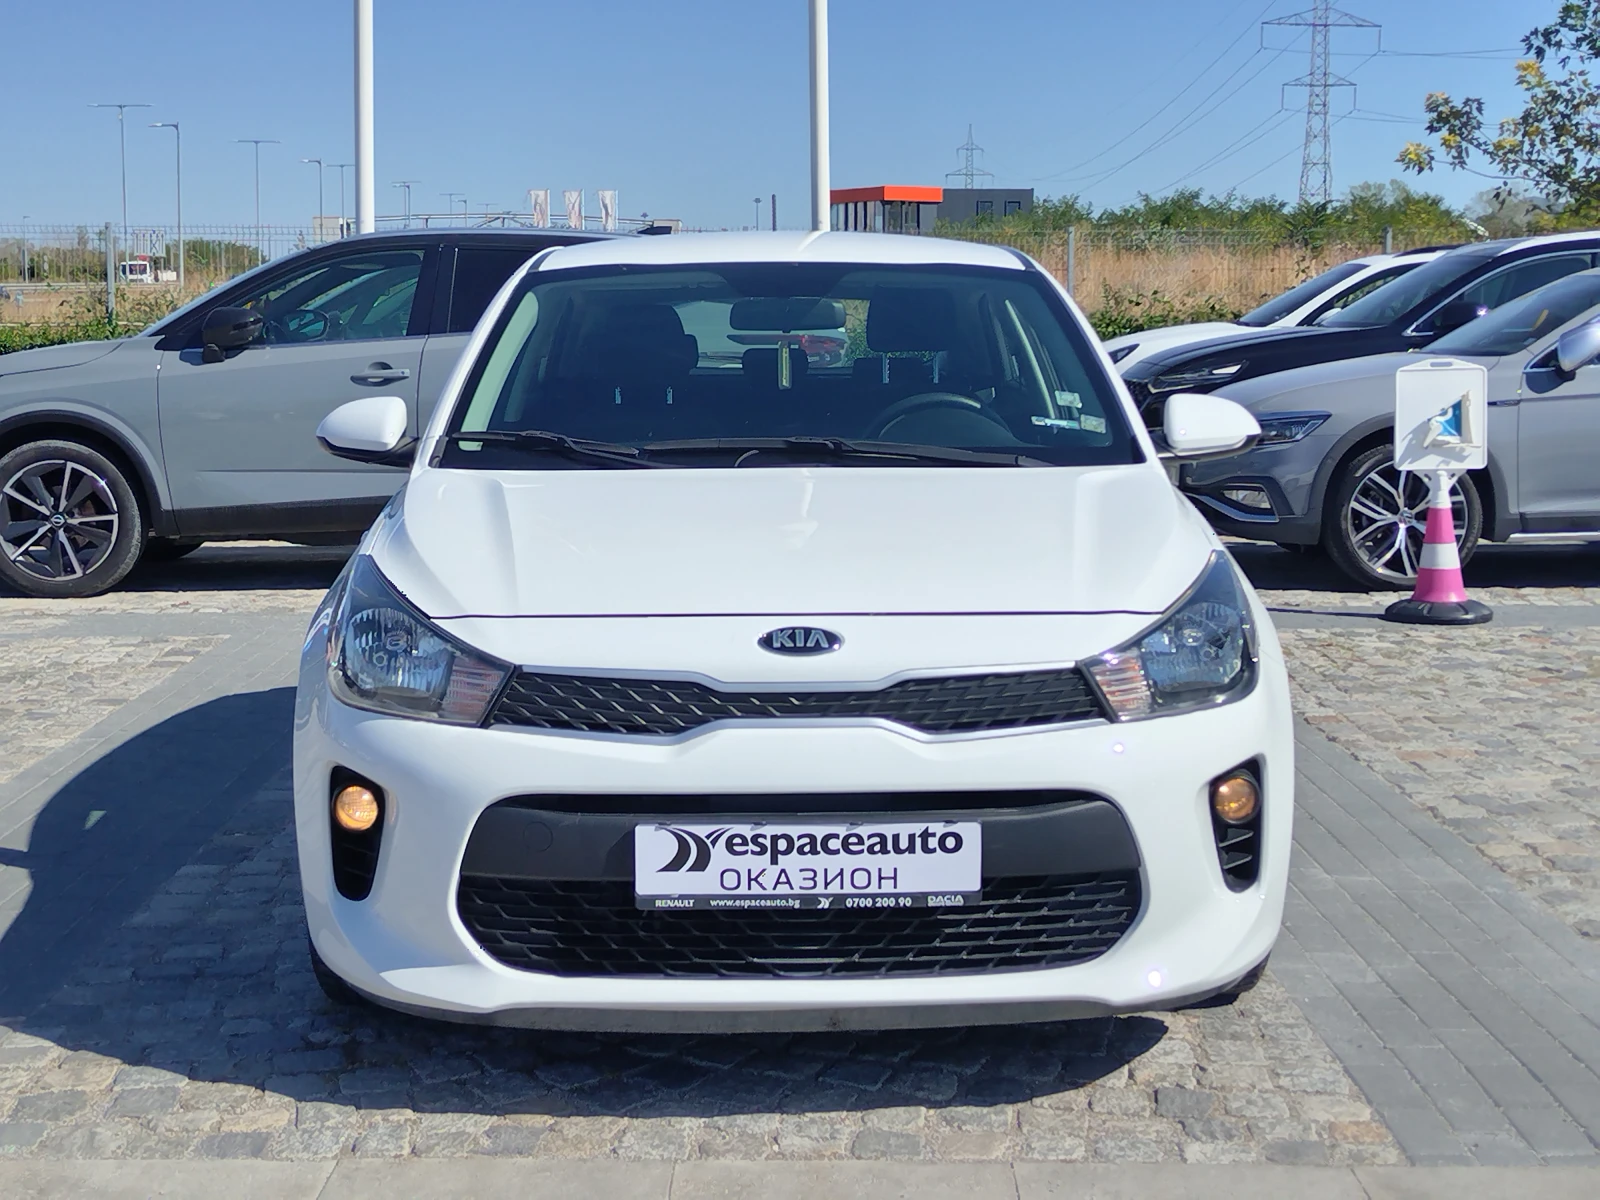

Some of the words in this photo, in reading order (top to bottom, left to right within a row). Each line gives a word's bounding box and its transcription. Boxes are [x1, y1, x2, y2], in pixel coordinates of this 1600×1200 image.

[772, 629, 829, 648] KIA
[724, 827, 964, 865] espaceauto
[720, 868, 898, 891] ОКАЗИОН
[655, 899, 695, 908] RENAULT
[710, 898, 801, 909] www.espaceauto.bg
[846, 898, 873, 908] 0700
[875, 898, 896, 908] 200
[898, 897, 912, 908] 90
[927, 895, 964, 907] DACIA
